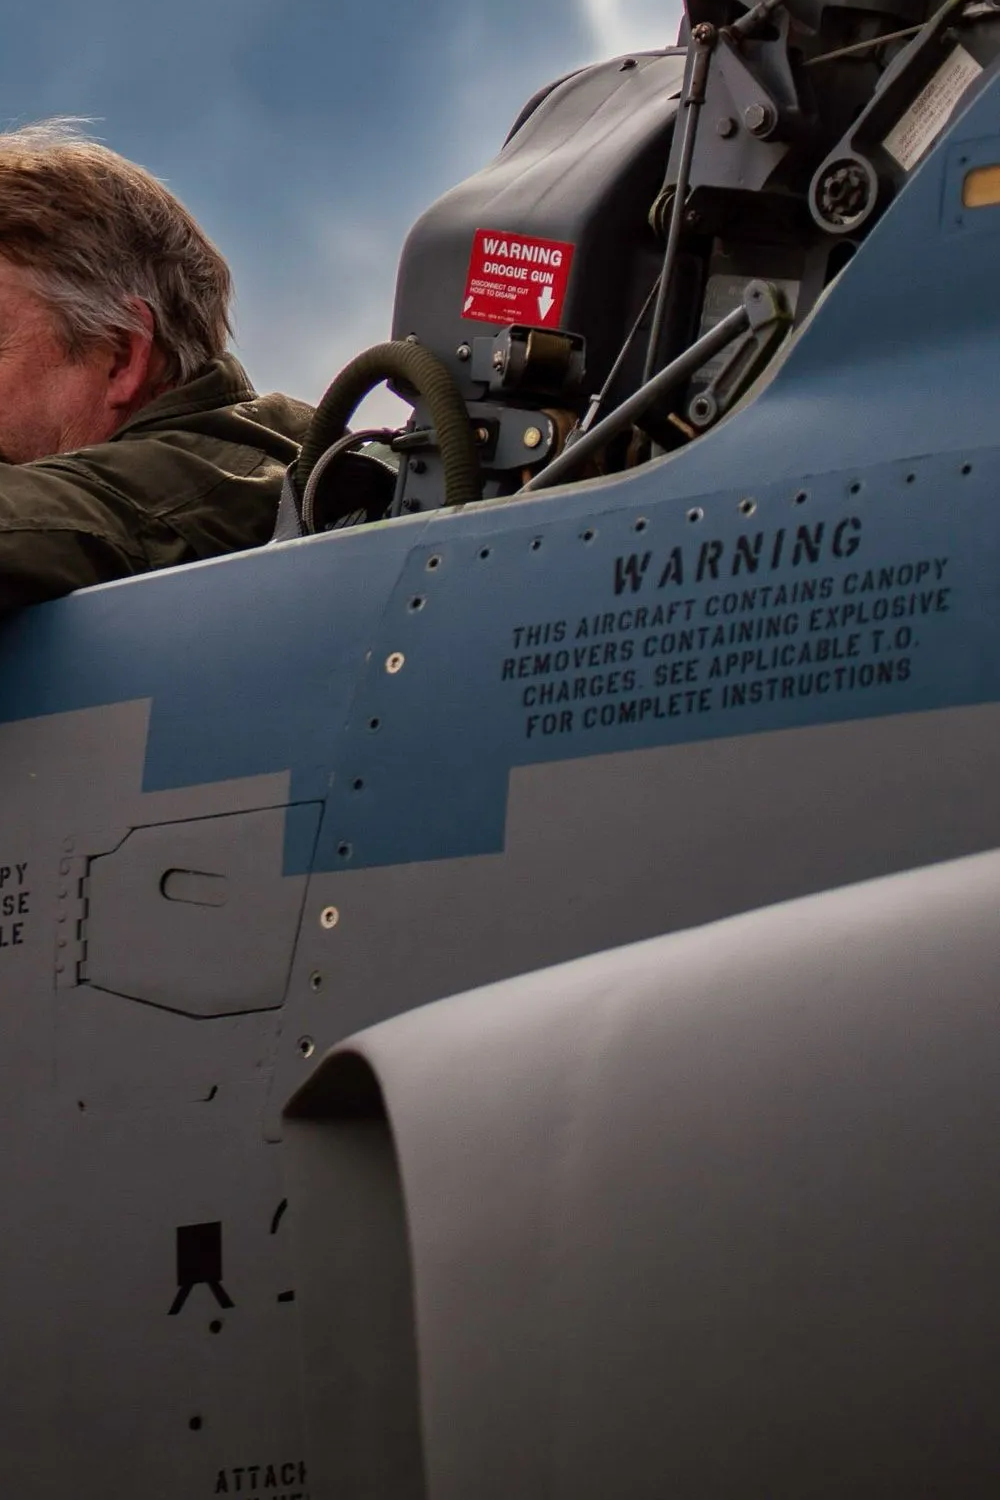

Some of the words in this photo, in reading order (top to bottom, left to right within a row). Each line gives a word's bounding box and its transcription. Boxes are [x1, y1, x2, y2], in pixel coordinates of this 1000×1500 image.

[470, 279, 506, 291] DISCONNECT
[507, 285, 516, 293] OR
[516, 287, 529, 295] CUT
[483, 238, 563, 267] WARNING
[483, 261, 528, 280] DROGUE
[531, 270, 554, 284] GUN
[470, 286, 485, 295] HOSE
[486, 289, 495, 297] TO
[495, 291, 517, 300] DISARM
[613, 516, 863, 596] WARNING
[501, 638, 635, 681] REMOVERS
[642, 612, 800, 658] CONTAINING
[808, 587, 952, 633] EXPLOSIVE
[512, 620, 567, 650] THIS
[575, 598, 697, 640] AIRCRAFT
[704, 576, 834, 618] CONTAINS
[842, 556, 950, 596] CANOPY
[522, 668, 643, 708] CHARGES.
[654, 658, 701, 688] SEE
[708, 632, 862, 680] APPLICABLE
[870, 626, 921, 655] T.O.
[526, 710, 574, 739] FOR
[582, 687, 713, 730] COMPLETE
[721, 657, 912, 709] INSTRUCTIONS
